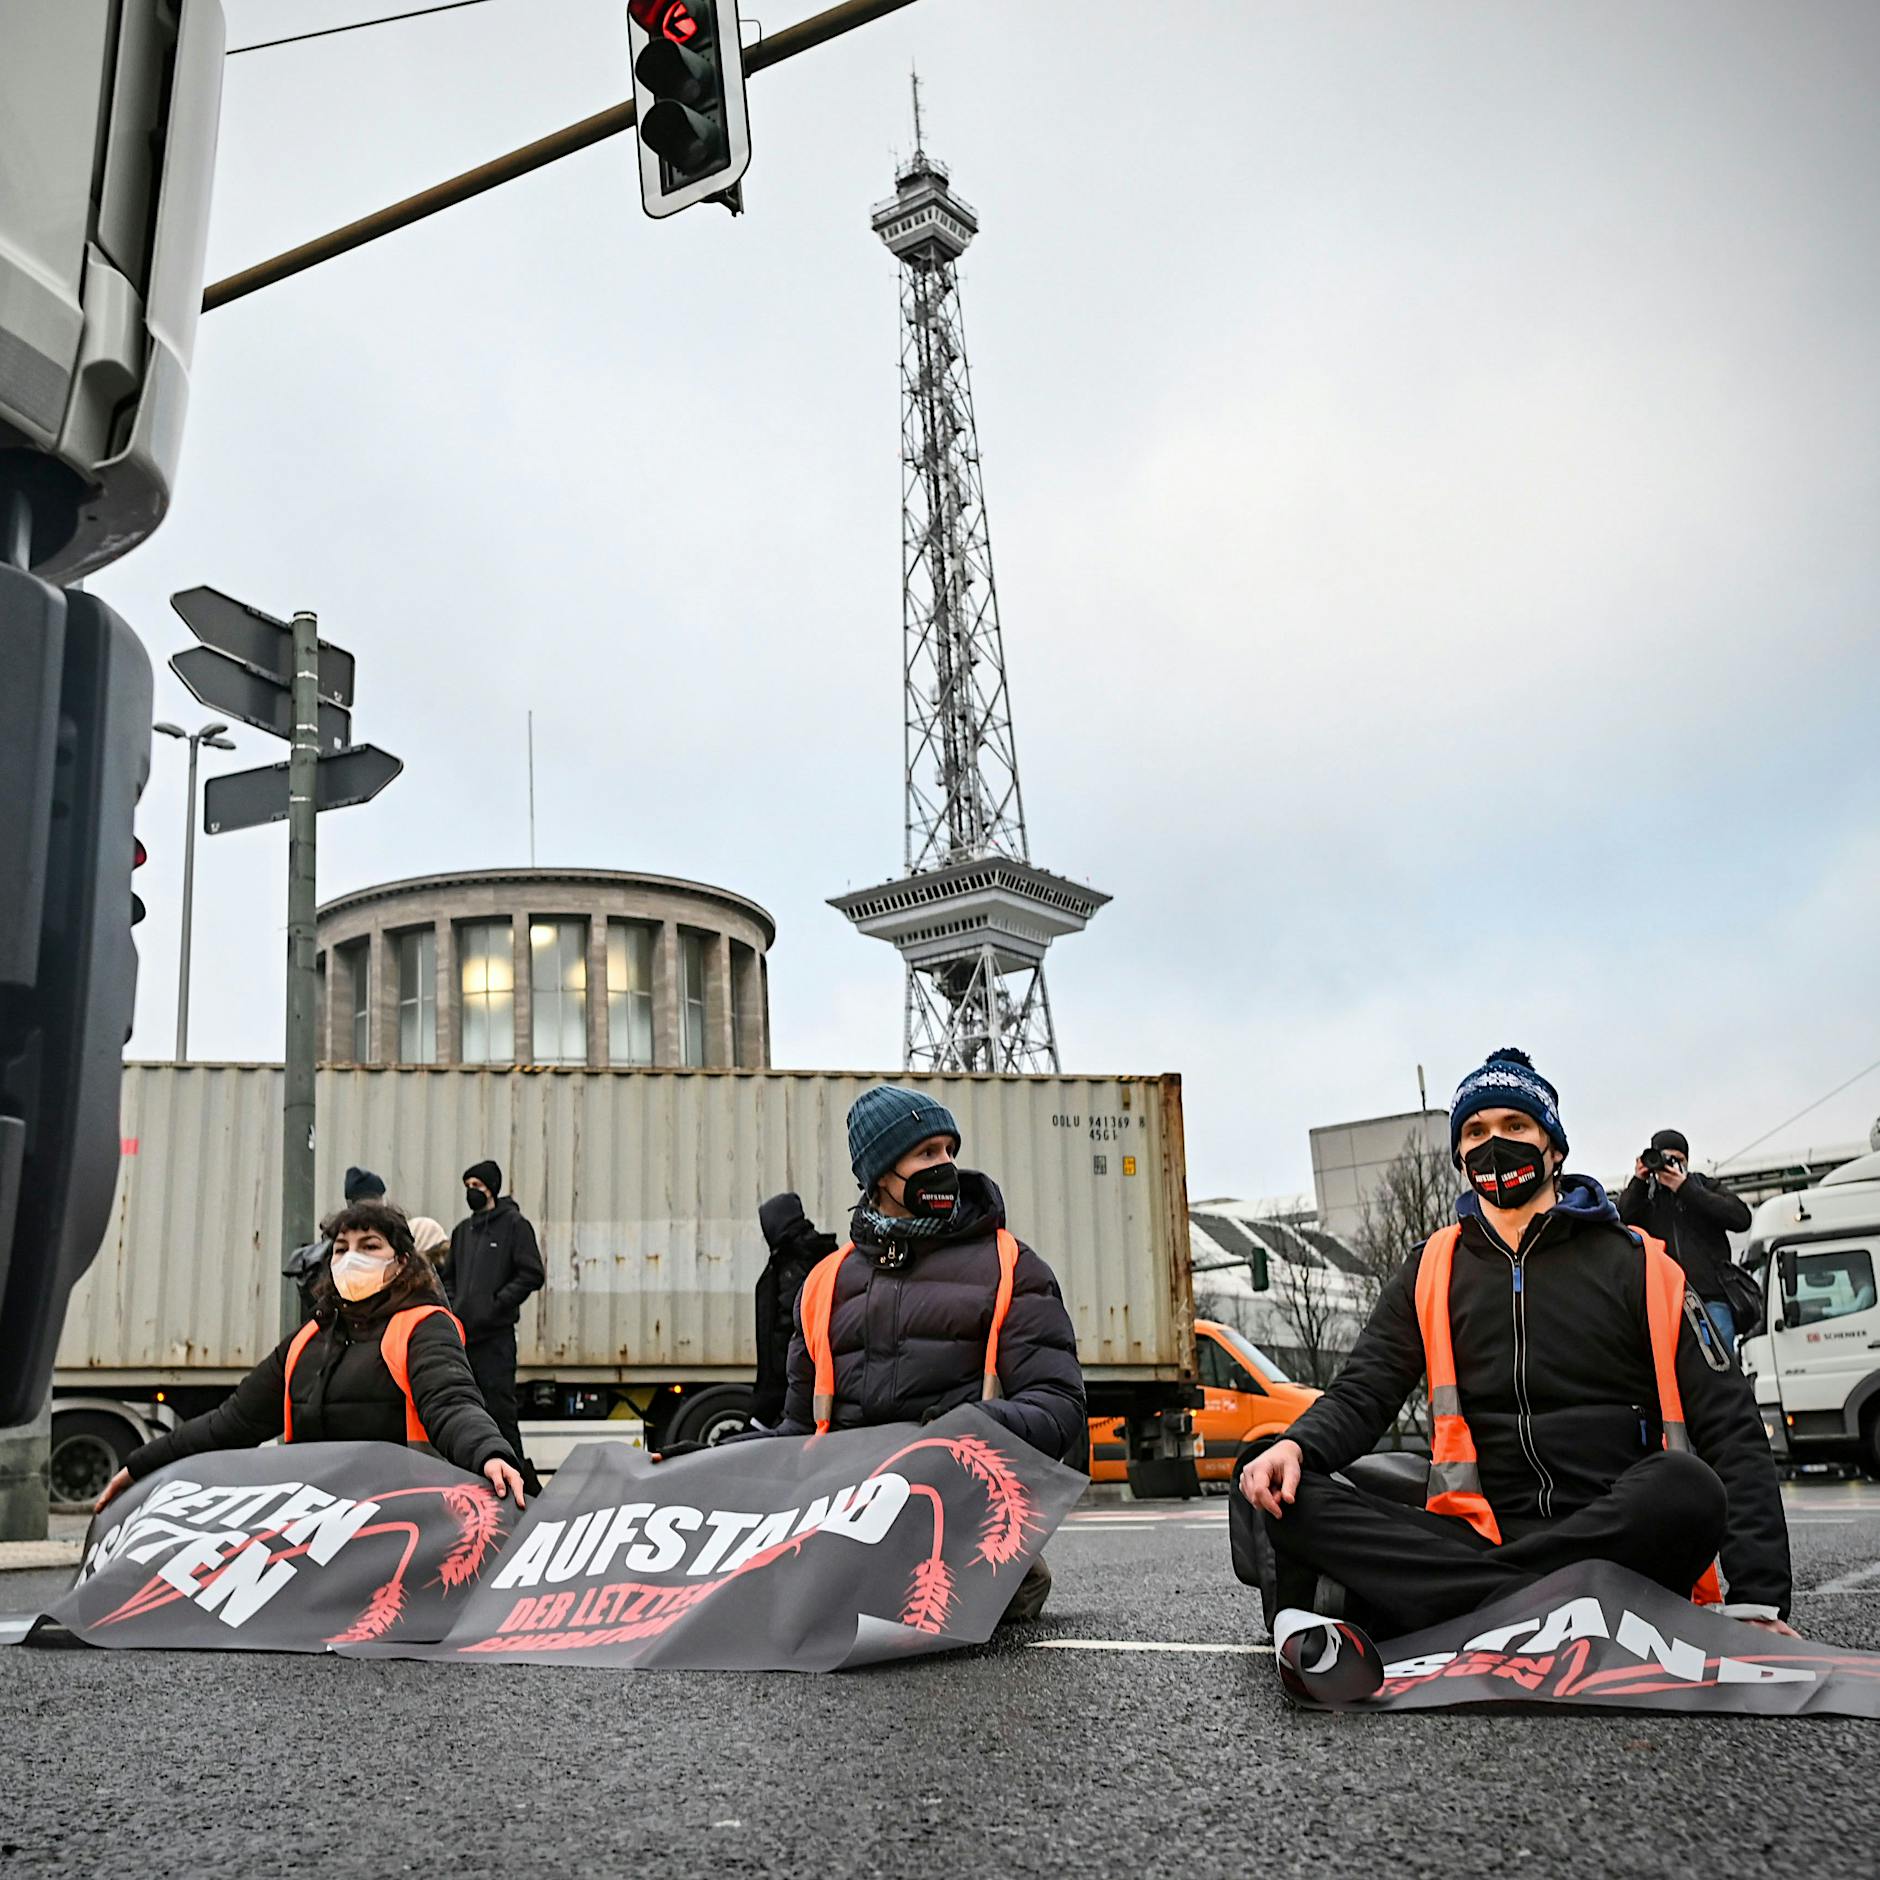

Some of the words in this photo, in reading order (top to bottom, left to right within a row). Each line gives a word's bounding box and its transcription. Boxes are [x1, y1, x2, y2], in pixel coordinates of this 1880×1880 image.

[1052, 1115, 1080, 1128] OOLU
[1089, 1115, 1130, 1128] 941369
[1089, 1129, 1117, 1141] 45G1
[921, 1193, 954, 1201] AUFSTAND
[496, 1590, 577, 1634] DER
[1383, 1596, 1817, 1683] STAND
